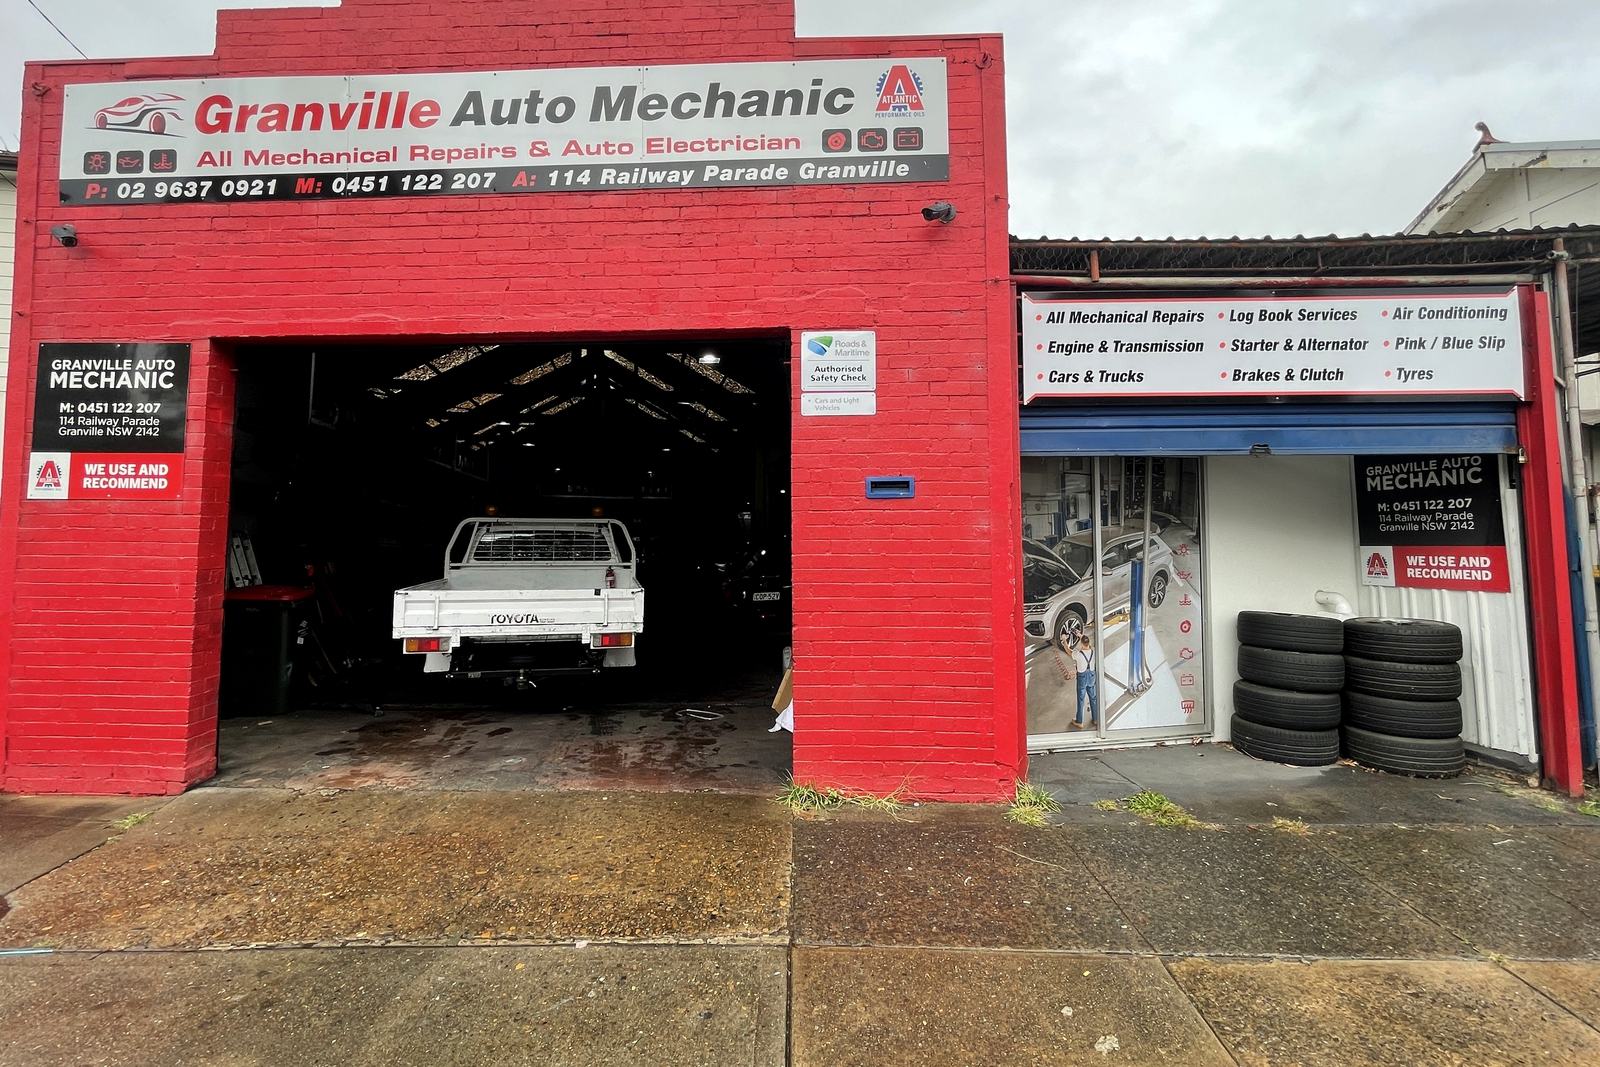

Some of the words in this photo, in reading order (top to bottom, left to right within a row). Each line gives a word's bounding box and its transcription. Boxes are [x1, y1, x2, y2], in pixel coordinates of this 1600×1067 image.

[881, 95, 918, 104] ATLANTIC
[194, 90, 441, 135] Granville
[449, 89, 576, 127] Auto
[588, 78, 855, 123] Mechanic
[197, 149, 231, 168] All
[243, 145, 397, 166] Mechanical
[409, 142, 517, 165] Repairs
[529, 140, 550, 158] &
[562, 138, 634, 157] Auto
[646, 134, 801, 155] Electrician
[85, 183, 107, 199] P:
[117, 182, 146, 199] 02
[154, 181, 213, 198] 9637
[221, 178, 277, 197] 0921
[294, 177, 322, 195] M:
[331, 177, 389, 194] 0451
[401, 173, 442, 191] 122
[450, 172, 497, 190] 207
[512, 171, 536, 187] A:
[548, 170, 591, 186] 114
[599, 167, 695, 186] Railway
[703, 164, 789, 182] Parade
[799, 160, 909, 180] Granville
[1046, 311, 1066, 324] All
[1069, 310, 1148, 324] Mechanical
[1152, 310, 1204, 325] Repairs
[1229, 309, 1254, 325] Log
[1258, 309, 1293, 322] Book
[1298, 308, 1358, 321] Services
[1393, 307, 1413, 320] Air
[1418, 306, 1508, 321] Conditioning
[834, 340, 860, 348] Roads
[1048, 340, 1094, 356] Engine
[1098, 340, 1109, 352] &
[1113, 340, 1204, 353] Transmission
[1230, 338, 1279, 352] Starter
[1283, 339, 1294, 351] &
[1297, 338, 1369, 351] Alternator
[1395, 337, 1426, 350] Pink
[1430, 336, 1438, 350] /
[1442, 336, 1473, 350] Blue
[1478, 335, 1506, 351] Slip
[834, 349, 870, 357] Maritime
[51, 359, 132, 370] GRANVILLE
[136, 359, 176, 370] AUTO
[815, 365, 863, 373] Authorised
[50, 371, 174, 389] MECHANIC
[810, 374, 839, 383] Safety
[841, 374, 866, 382] Check
[1049, 370, 1079, 383] Cars
[1083, 370, 1094, 383] &
[1098, 369, 1144, 383] Trucks
[1232, 368, 1280, 382] Brakes
[1285, 369, 1295, 381] &
[1300, 367, 1344, 381] Clutch
[1396, 367, 1434, 383] Tyres
[59, 403, 75, 413] M:
[77, 403, 108, 413] 0451
[112, 403, 132, 413] 122
[136, 403, 161, 413] 207
[59, 416, 74, 426] 114
[77, 416, 119, 428] Railway
[122, 416, 160, 426] Parade
[58, 427, 103, 436] Granville
[106, 427, 133, 436] NSW
[136, 427, 160, 436] 2142
[84, 464, 105, 475] WE
[109, 464, 136, 475] USE
[139, 464, 169, 475] AND
[1366, 459, 1438, 476] GRANVILLE
[1442, 455, 1482, 469] AUTO
[83, 478, 168, 489] RECOMMEND
[1366, 467, 1483, 492] MECHANIC
[1378, 503, 1390, 512] M:
[1393, 501, 1420, 511] 0451
[1424, 500, 1444, 510] 122
[1448, 498, 1472, 509] 207
[1379, 514, 1392, 522] 114
[1394, 512, 1432, 523] Railway
[1435, 511, 1474, 521] Parade
[1379, 522, 1419, 532] Granville
[1422, 522, 1447, 531] NSW
[1450, 521, 1475, 530] 2142
[1406, 556, 1426, 566] WE
[1429, 556, 1456, 567] USE
[1459, 556, 1491, 568] AND
[1407, 568, 1492, 581] RECOMMEND
[490, 613, 539, 624] TOYOTA
